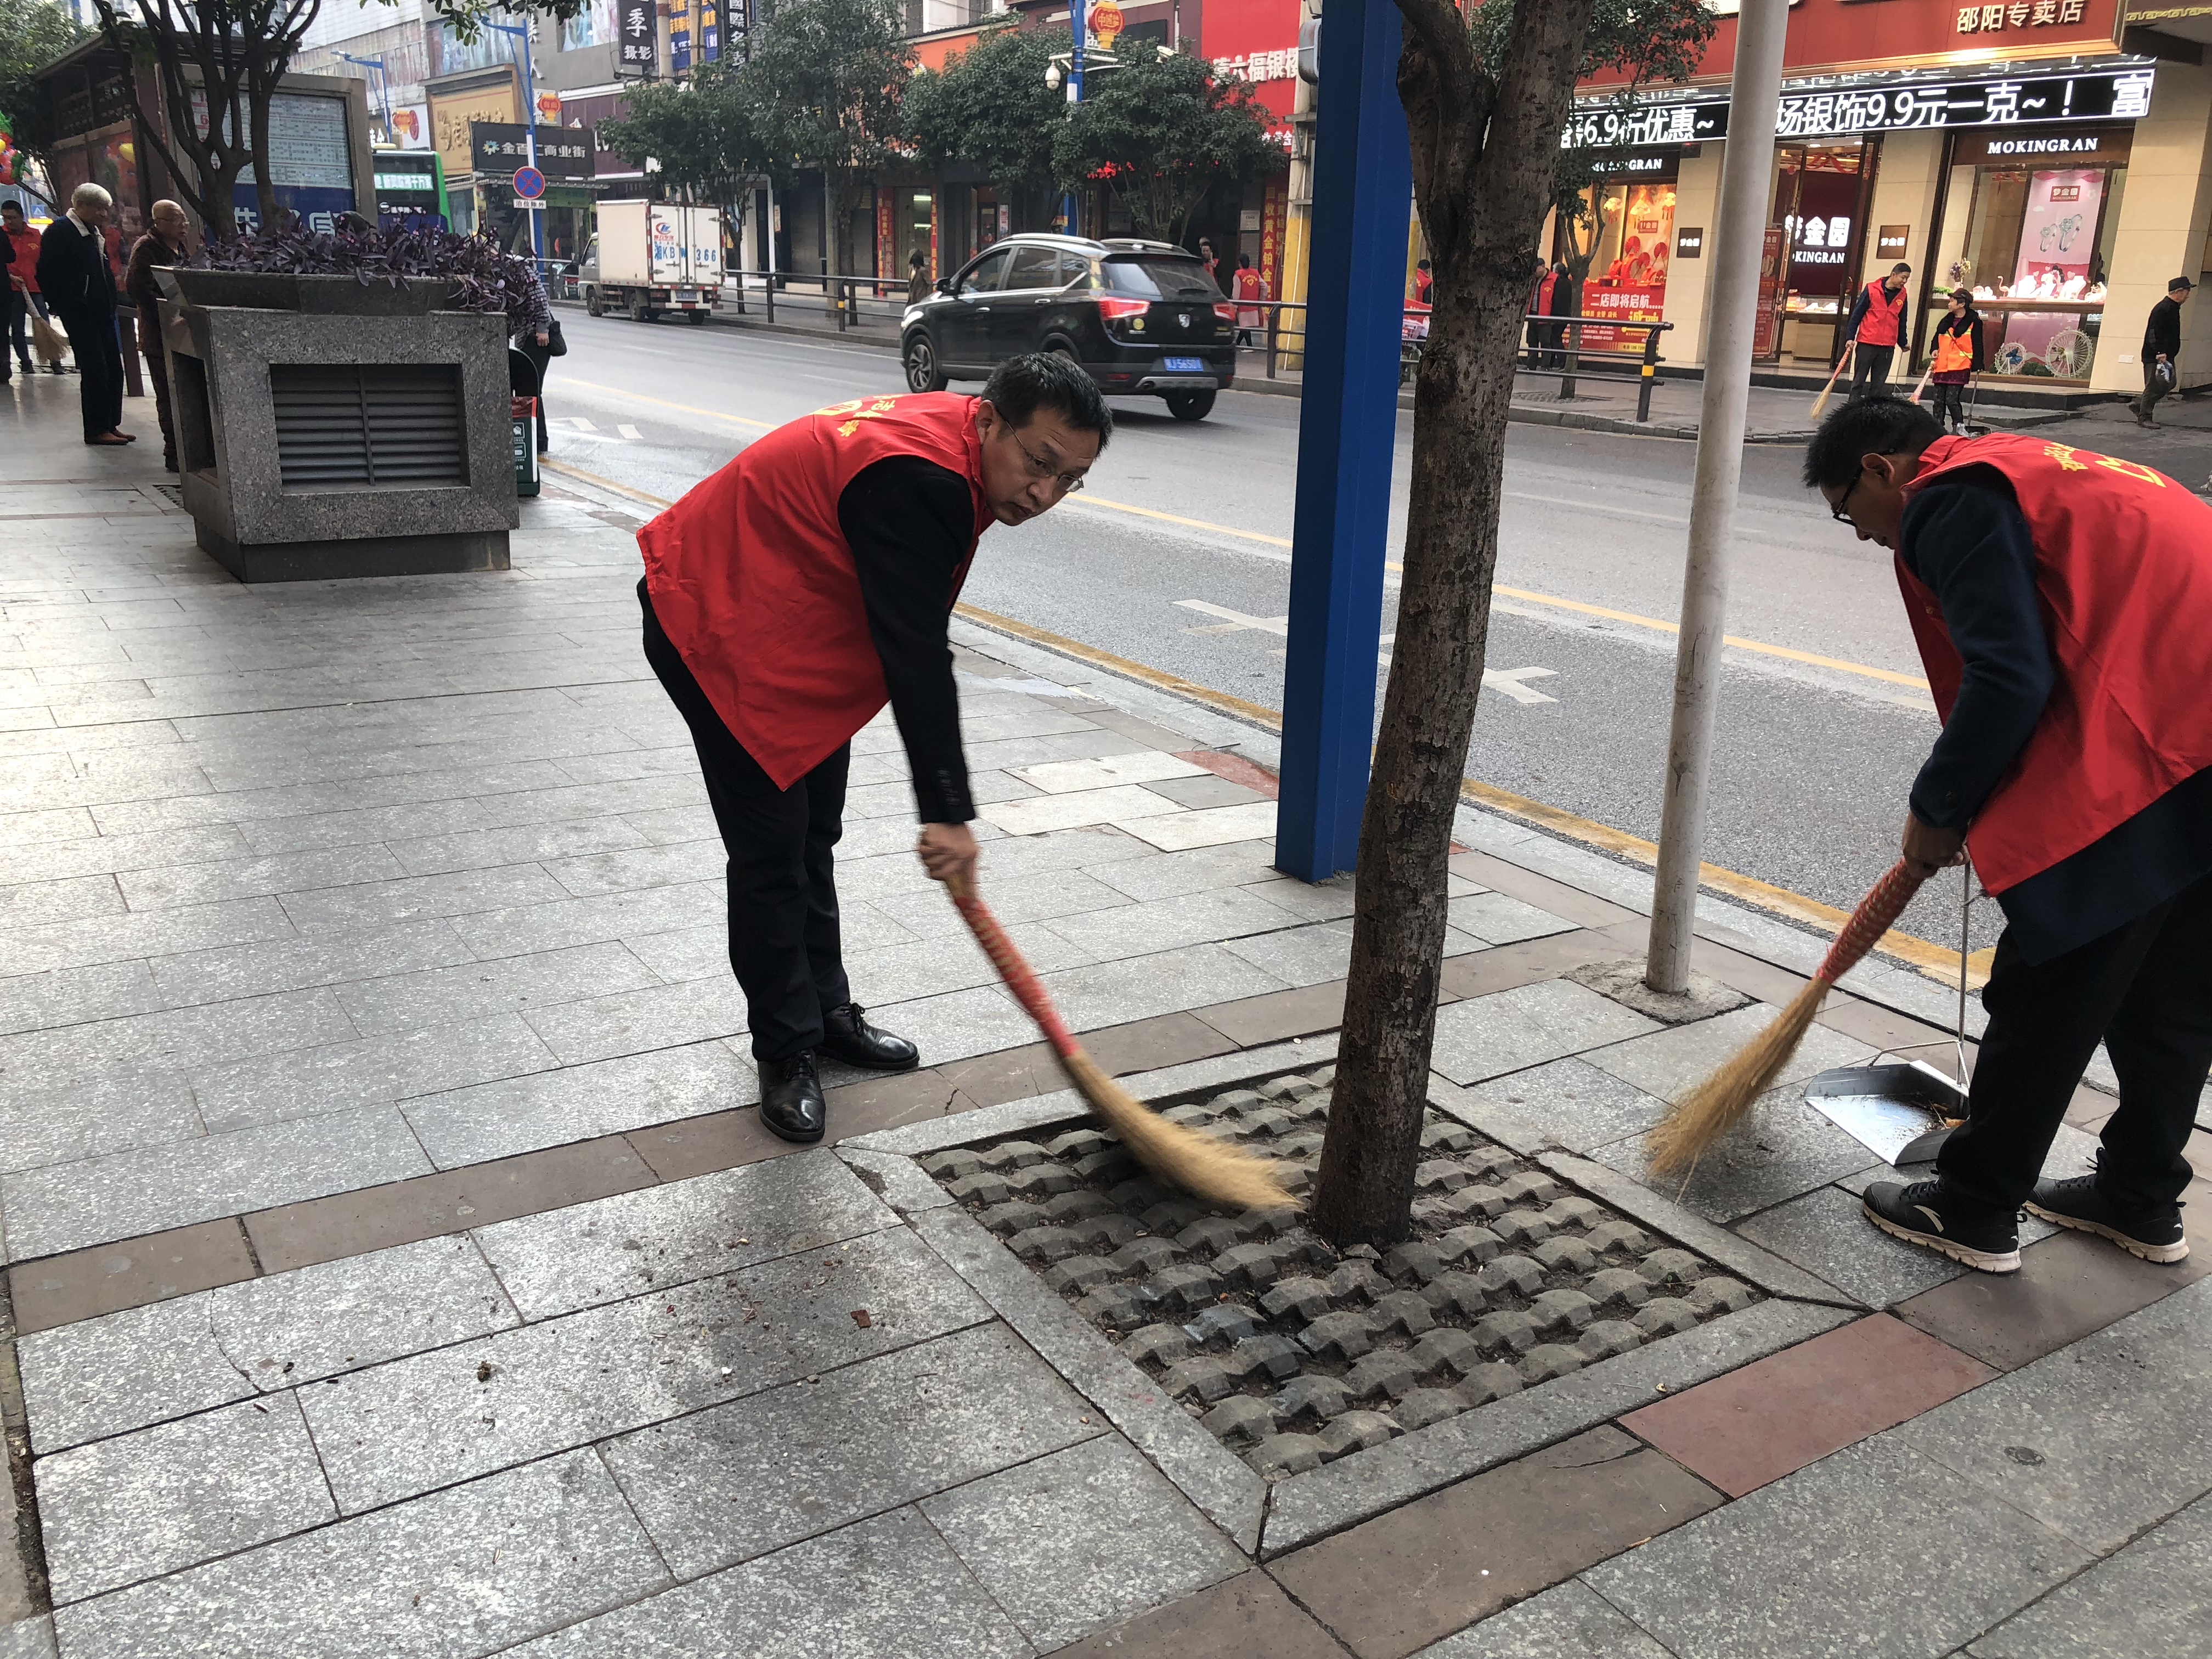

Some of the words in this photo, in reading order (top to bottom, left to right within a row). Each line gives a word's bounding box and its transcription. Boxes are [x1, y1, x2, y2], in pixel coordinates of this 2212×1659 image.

[625, 7, 647, 38] 季
[1956, 0, 2085, 32] 邵阳专卖店
[623, 44, 653, 61] 摄影
[2111, 74, 2151, 116] 富
[1987, 137, 2099, 154] MOKINGRAN
[1792, 250, 1846, 264] KINGRAN
